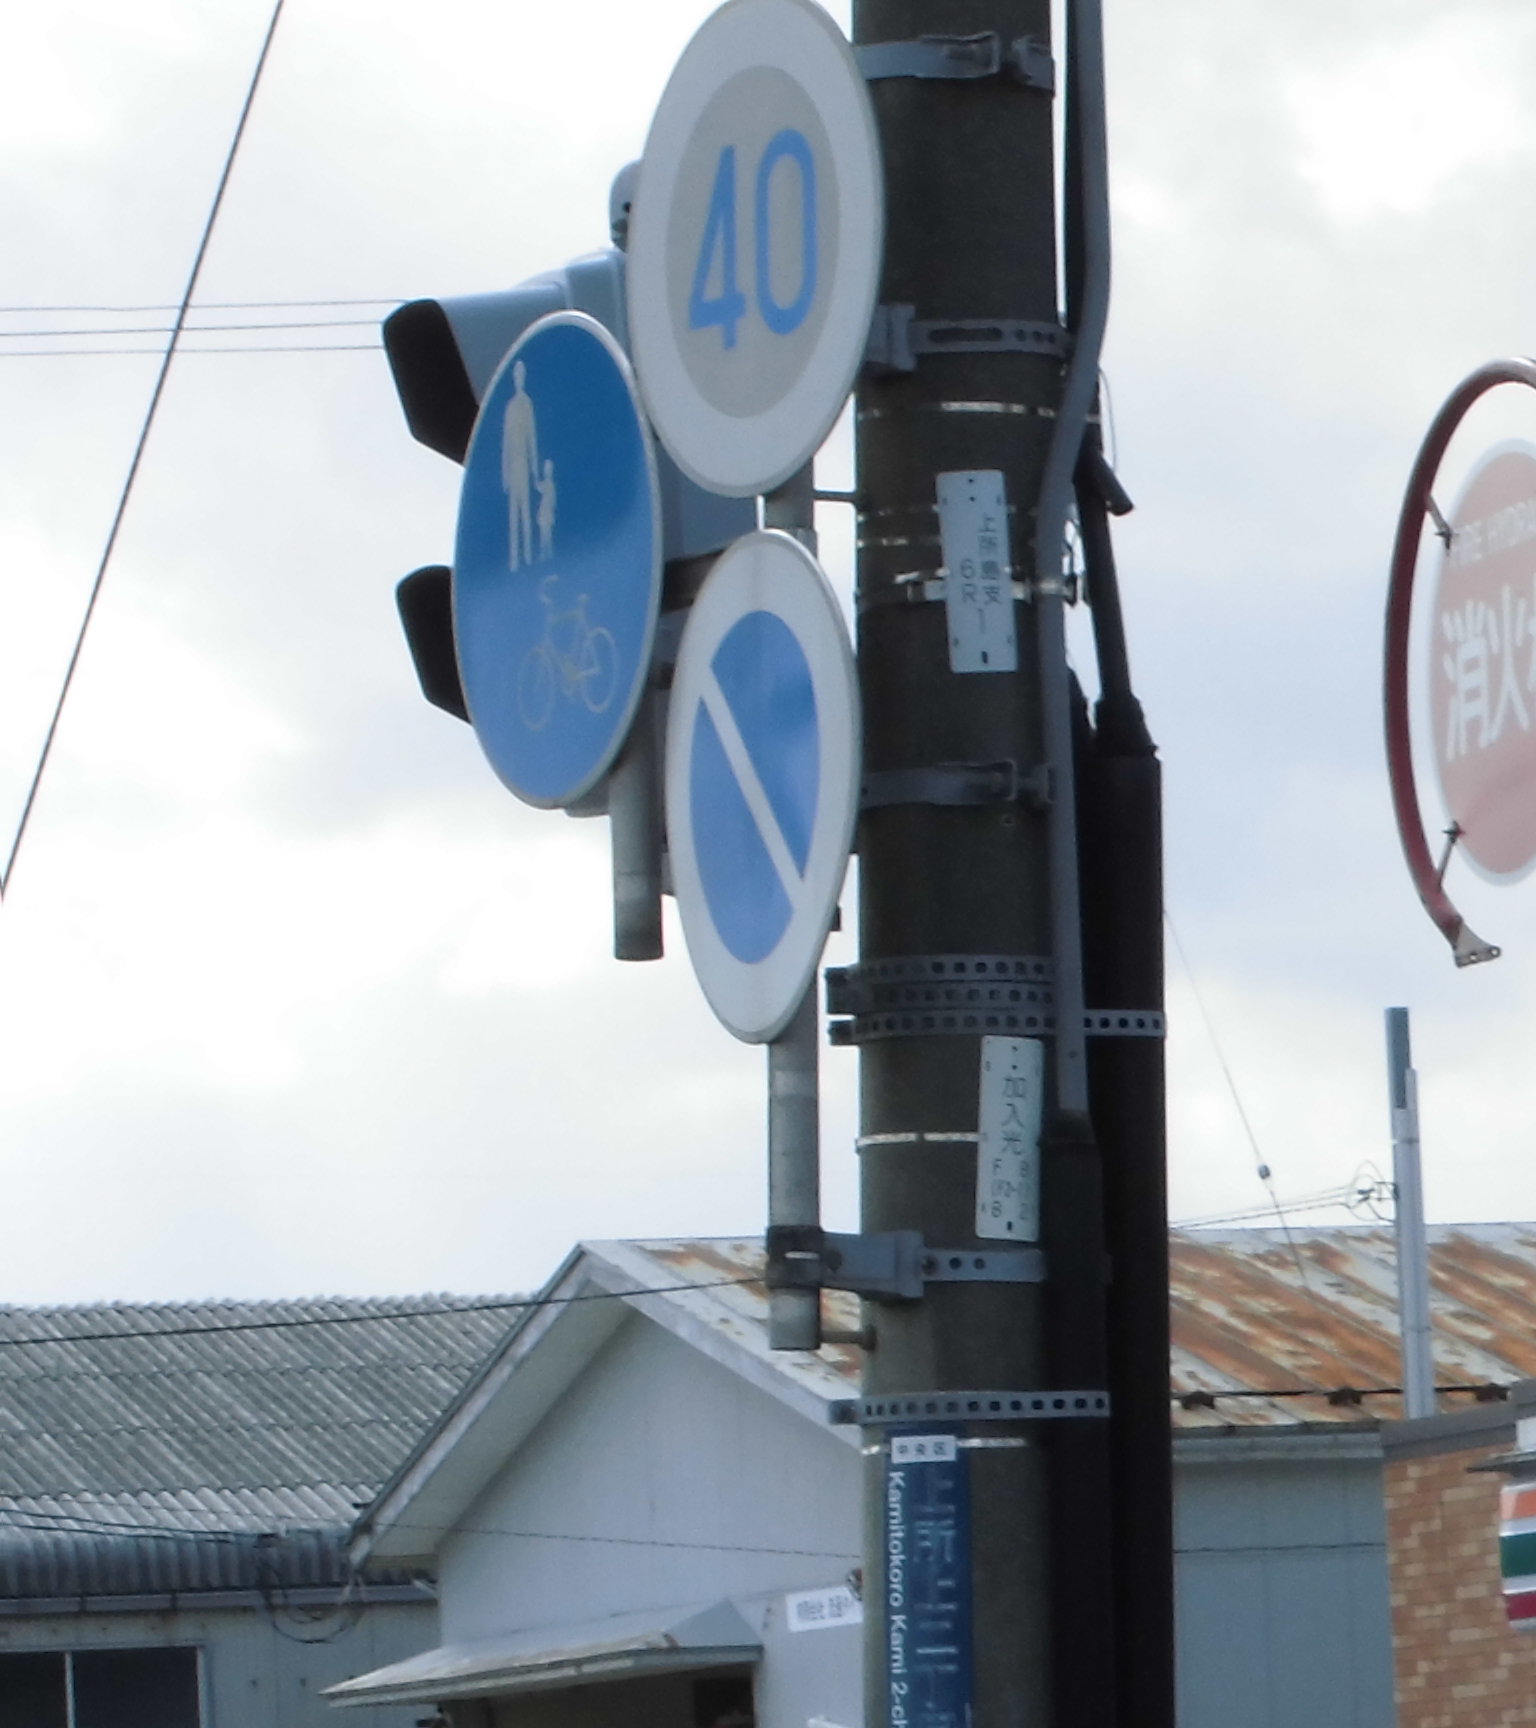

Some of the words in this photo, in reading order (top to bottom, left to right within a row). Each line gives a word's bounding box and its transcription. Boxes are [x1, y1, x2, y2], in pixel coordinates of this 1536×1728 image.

[688, 127, 818, 350] 40
[887, 1471, 905, 1606] Kamitokoro
[890, 1614, 908, 1675] Kami
